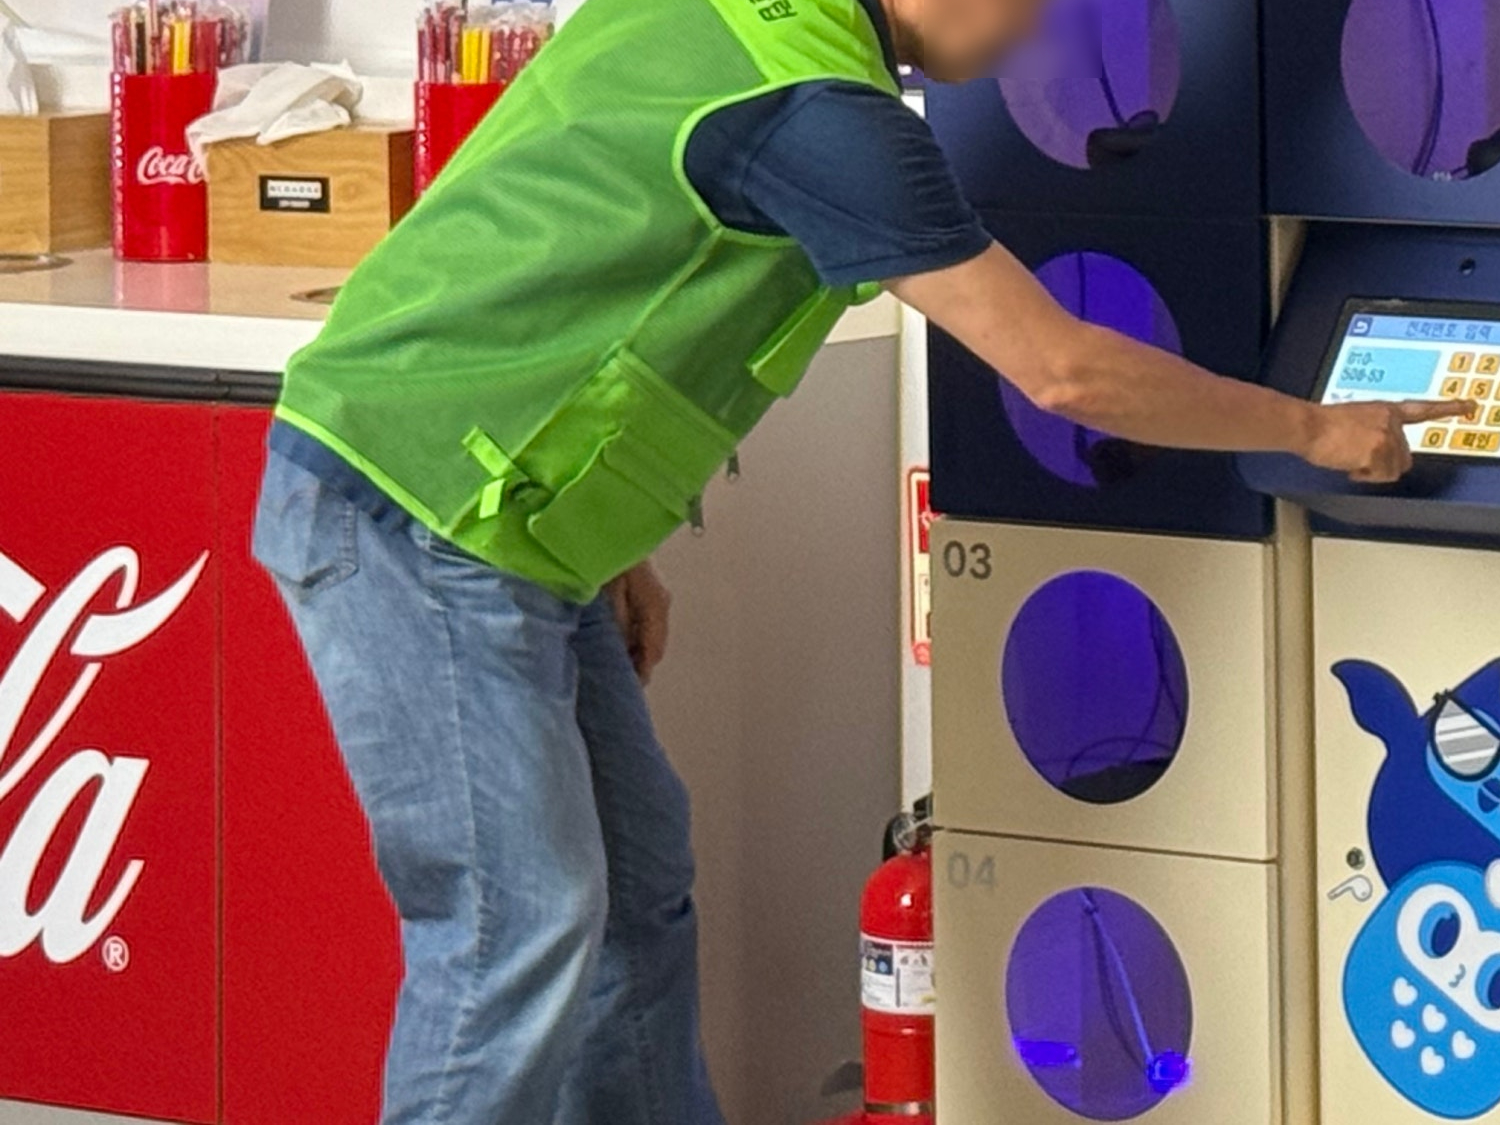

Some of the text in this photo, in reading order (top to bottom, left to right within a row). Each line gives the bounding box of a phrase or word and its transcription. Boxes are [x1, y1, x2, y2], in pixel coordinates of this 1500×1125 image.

[1484, 357, 1495, 371] 2
[1446, 380, 1458, 394] 4
[1474, 382, 1486, 397] 5
[1428, 431, 1440, 446] 0
[943, 541, 993, 580] 03
[947, 853, 998, 891] 04
